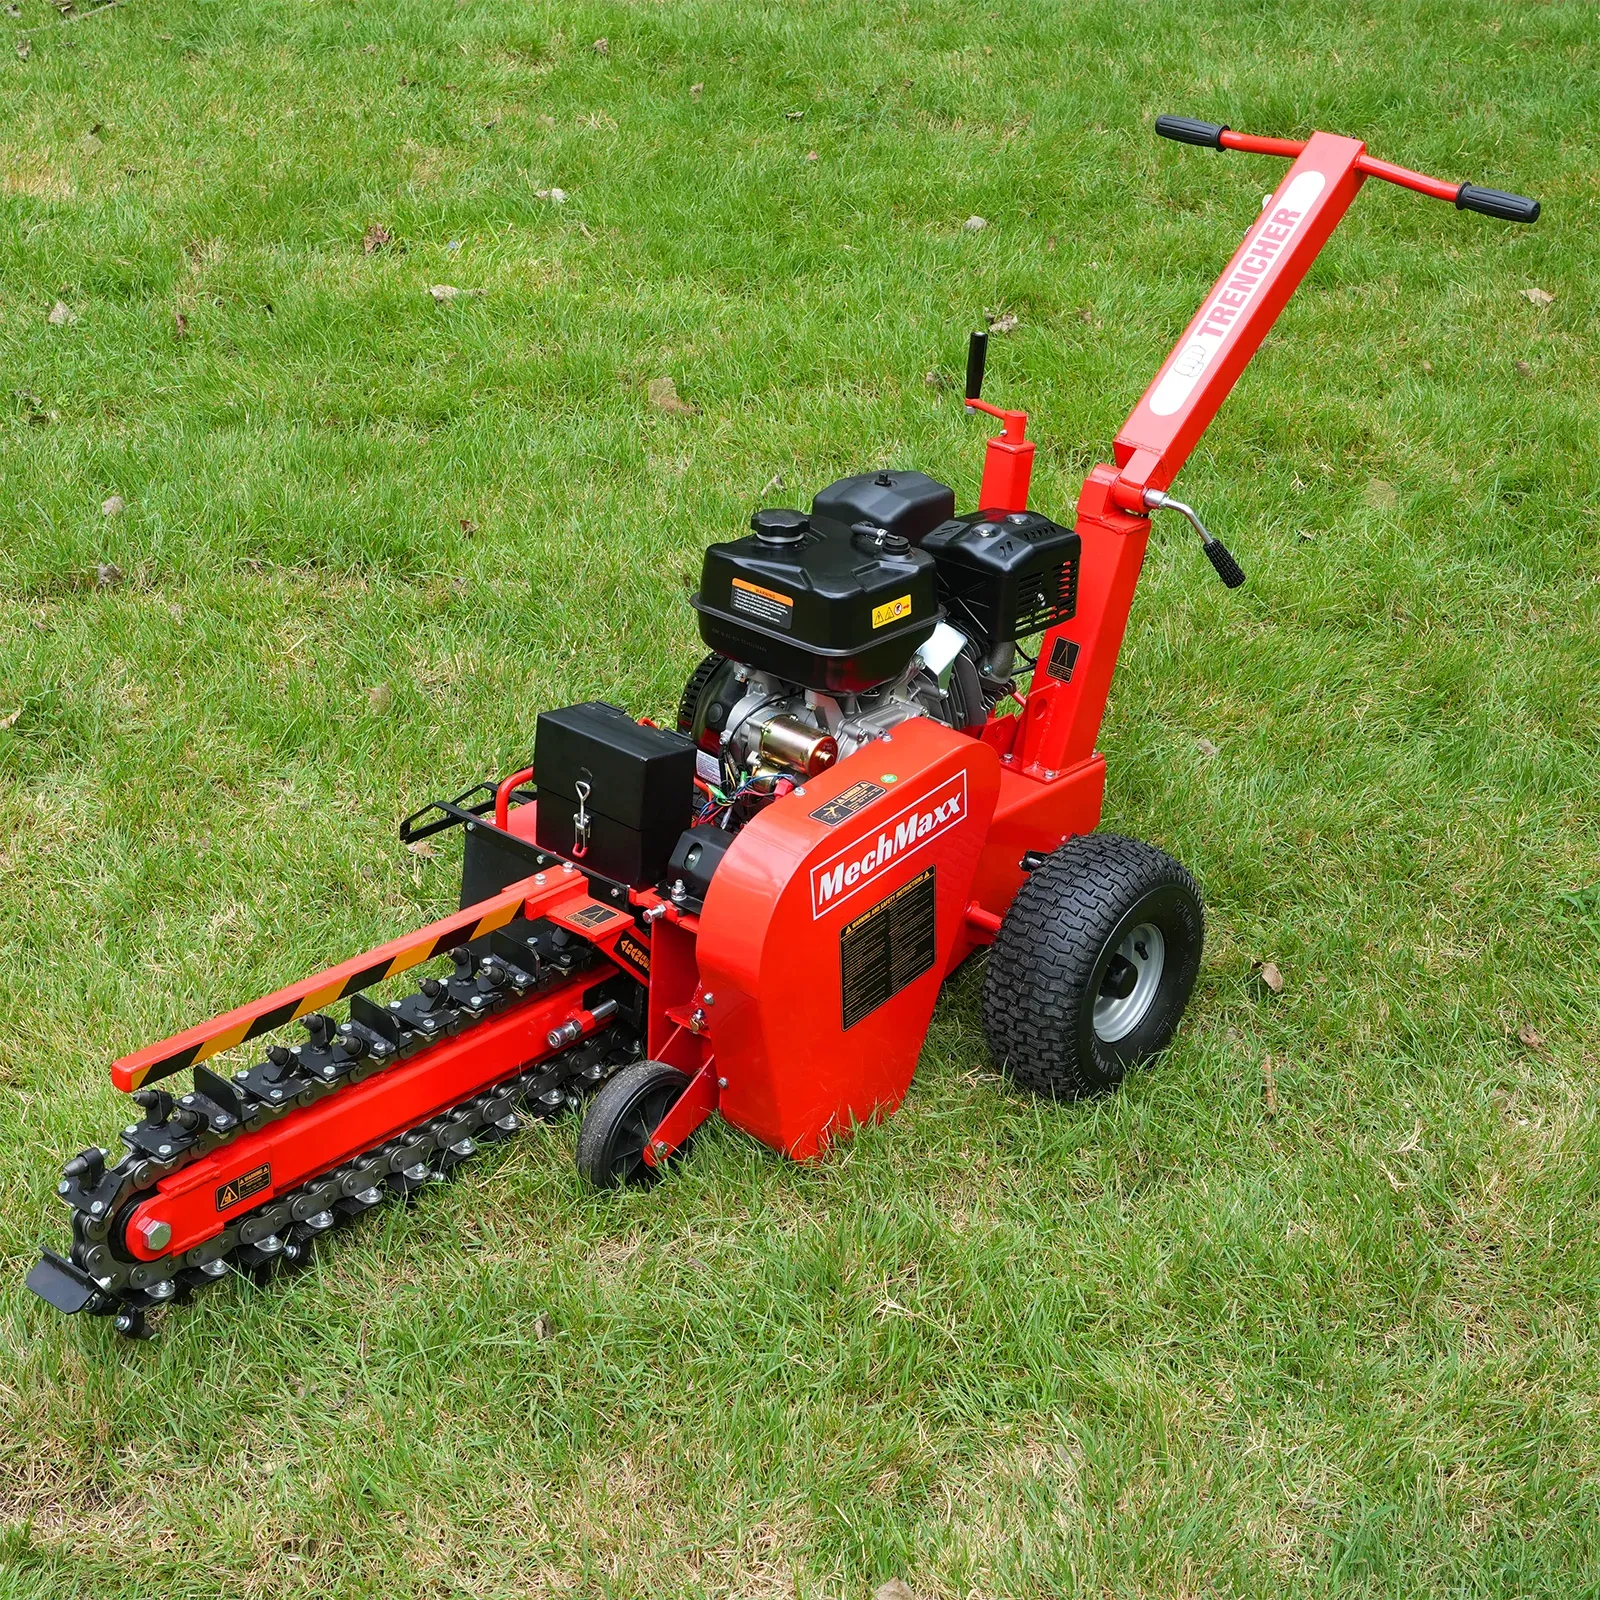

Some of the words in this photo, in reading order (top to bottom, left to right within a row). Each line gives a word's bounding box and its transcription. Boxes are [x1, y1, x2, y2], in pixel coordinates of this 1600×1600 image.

[1197, 207, 1302, 338] TRENCHER
[818, 791, 962, 906] MechMaxx
[624, 942, 651, 972] DANGE
